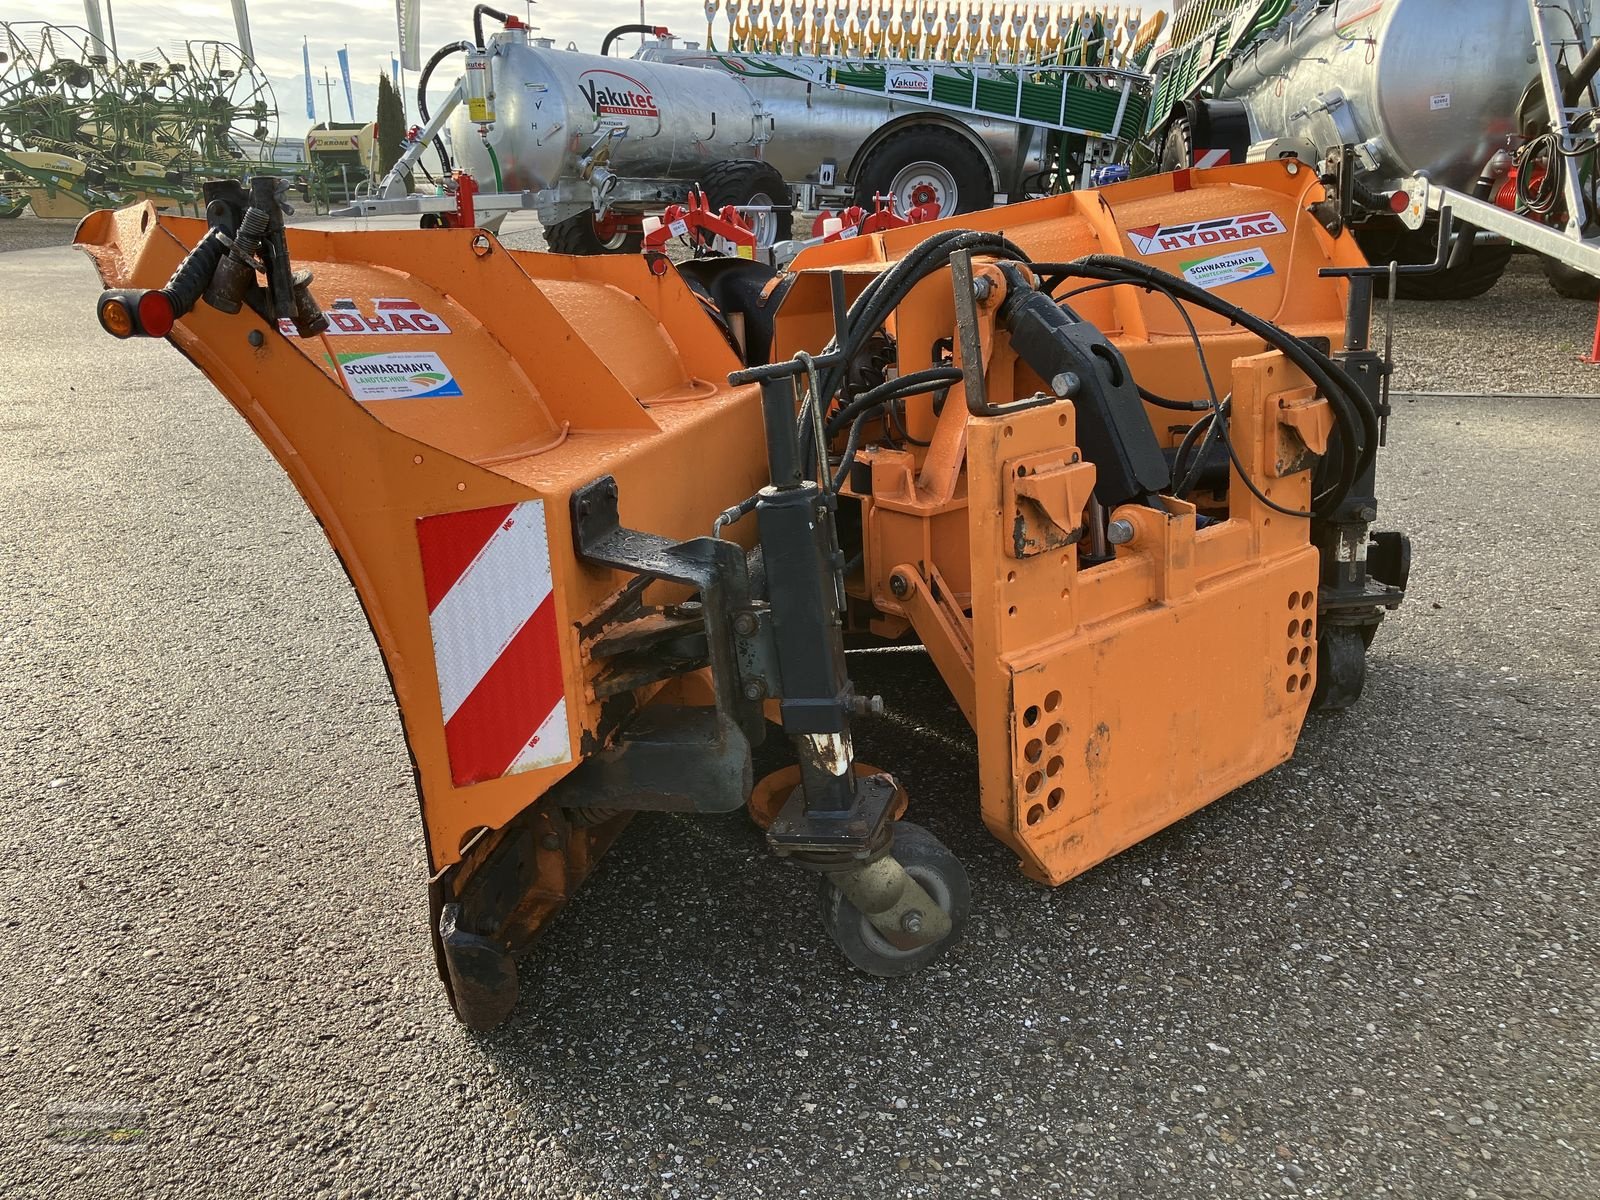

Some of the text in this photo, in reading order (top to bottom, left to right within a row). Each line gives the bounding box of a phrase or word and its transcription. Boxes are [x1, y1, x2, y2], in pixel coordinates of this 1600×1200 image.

[890, 76, 928, 88] Vakutec
[578, 79, 657, 112] Vakutec
[1158, 221, 1278, 250] HYDRAC
[1190, 256, 1255, 275] SCHWARZMAYR
[1194, 268, 1233, 280] LANDTECHNIK
[343, 363, 434, 375] SCHWARZMAYR
[353, 375, 408, 384] LANDTECHNIK
[502, 518, 514, 531] 3M
[528, 735, 540, 748] 3M
